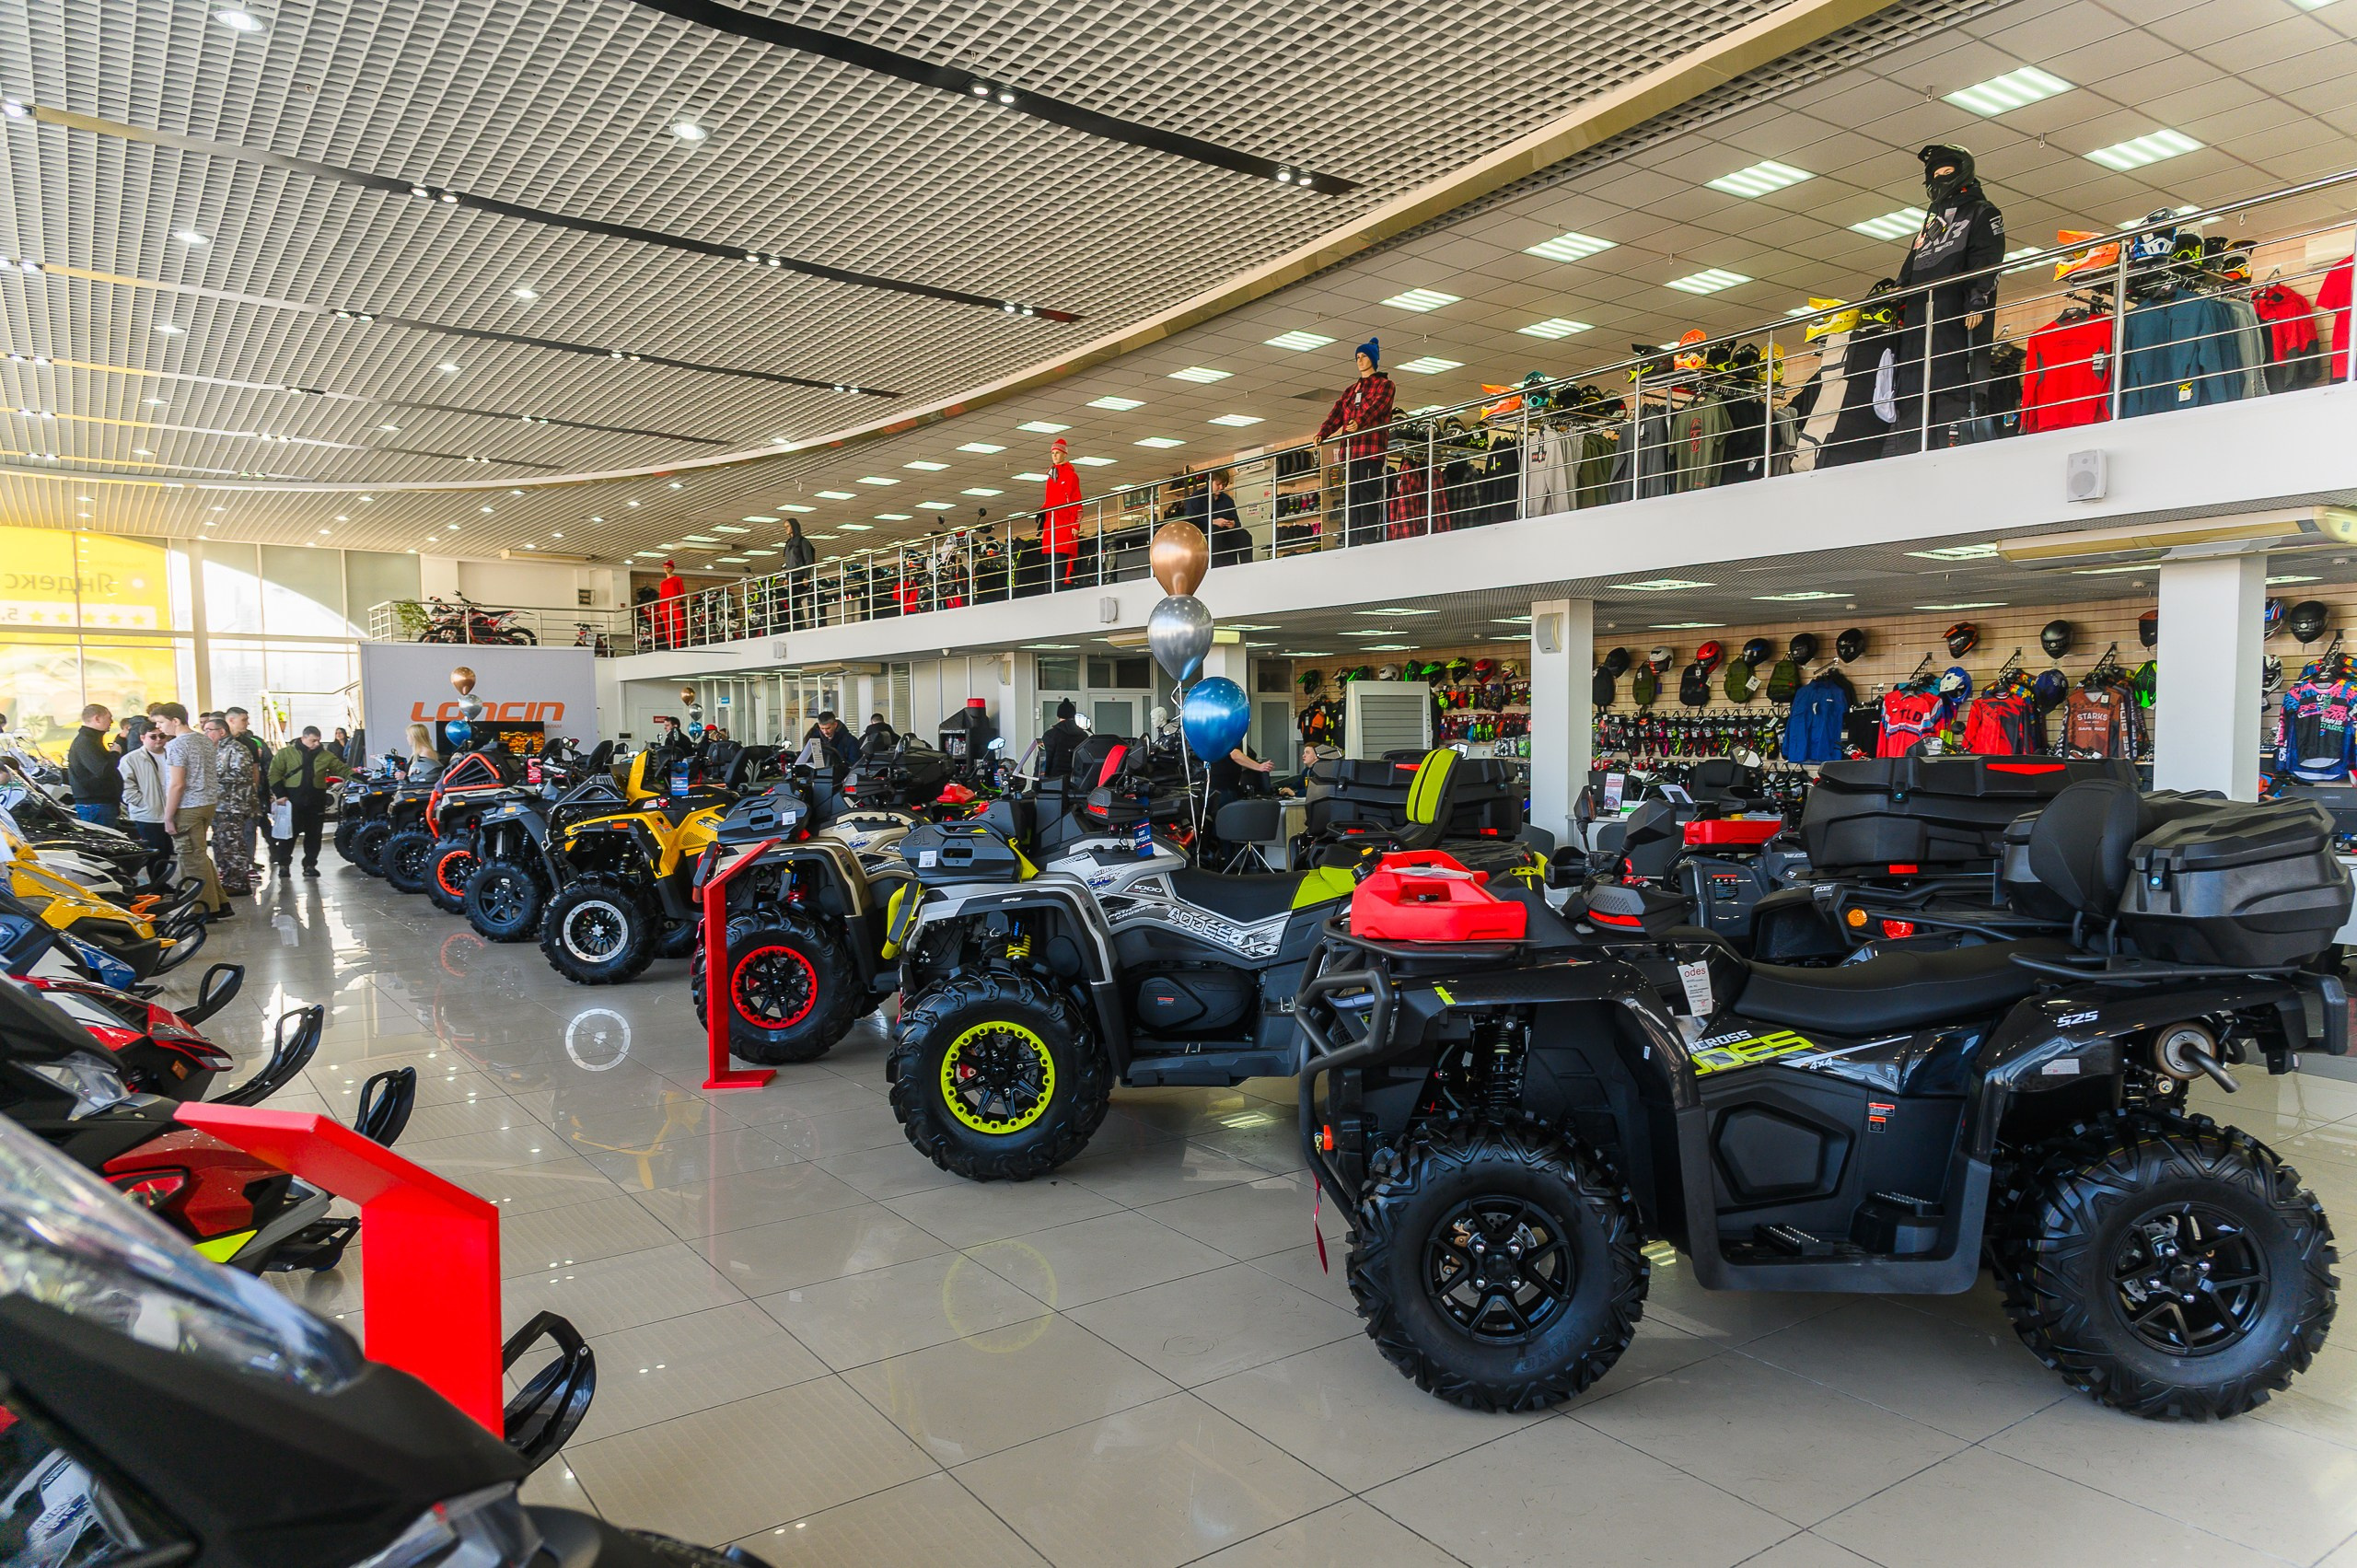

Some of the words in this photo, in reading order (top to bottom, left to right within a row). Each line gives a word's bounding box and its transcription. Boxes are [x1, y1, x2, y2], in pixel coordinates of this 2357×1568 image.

[1899, 708, 1923, 722] TLD
[2076, 712, 2108, 721] STARKS
[912, 833, 931, 846] 5L
[1684, 968, 1706, 978] odes
[2056, 1010, 2099, 1028] 525
[1808, 1057, 1834, 1071] 4x4
